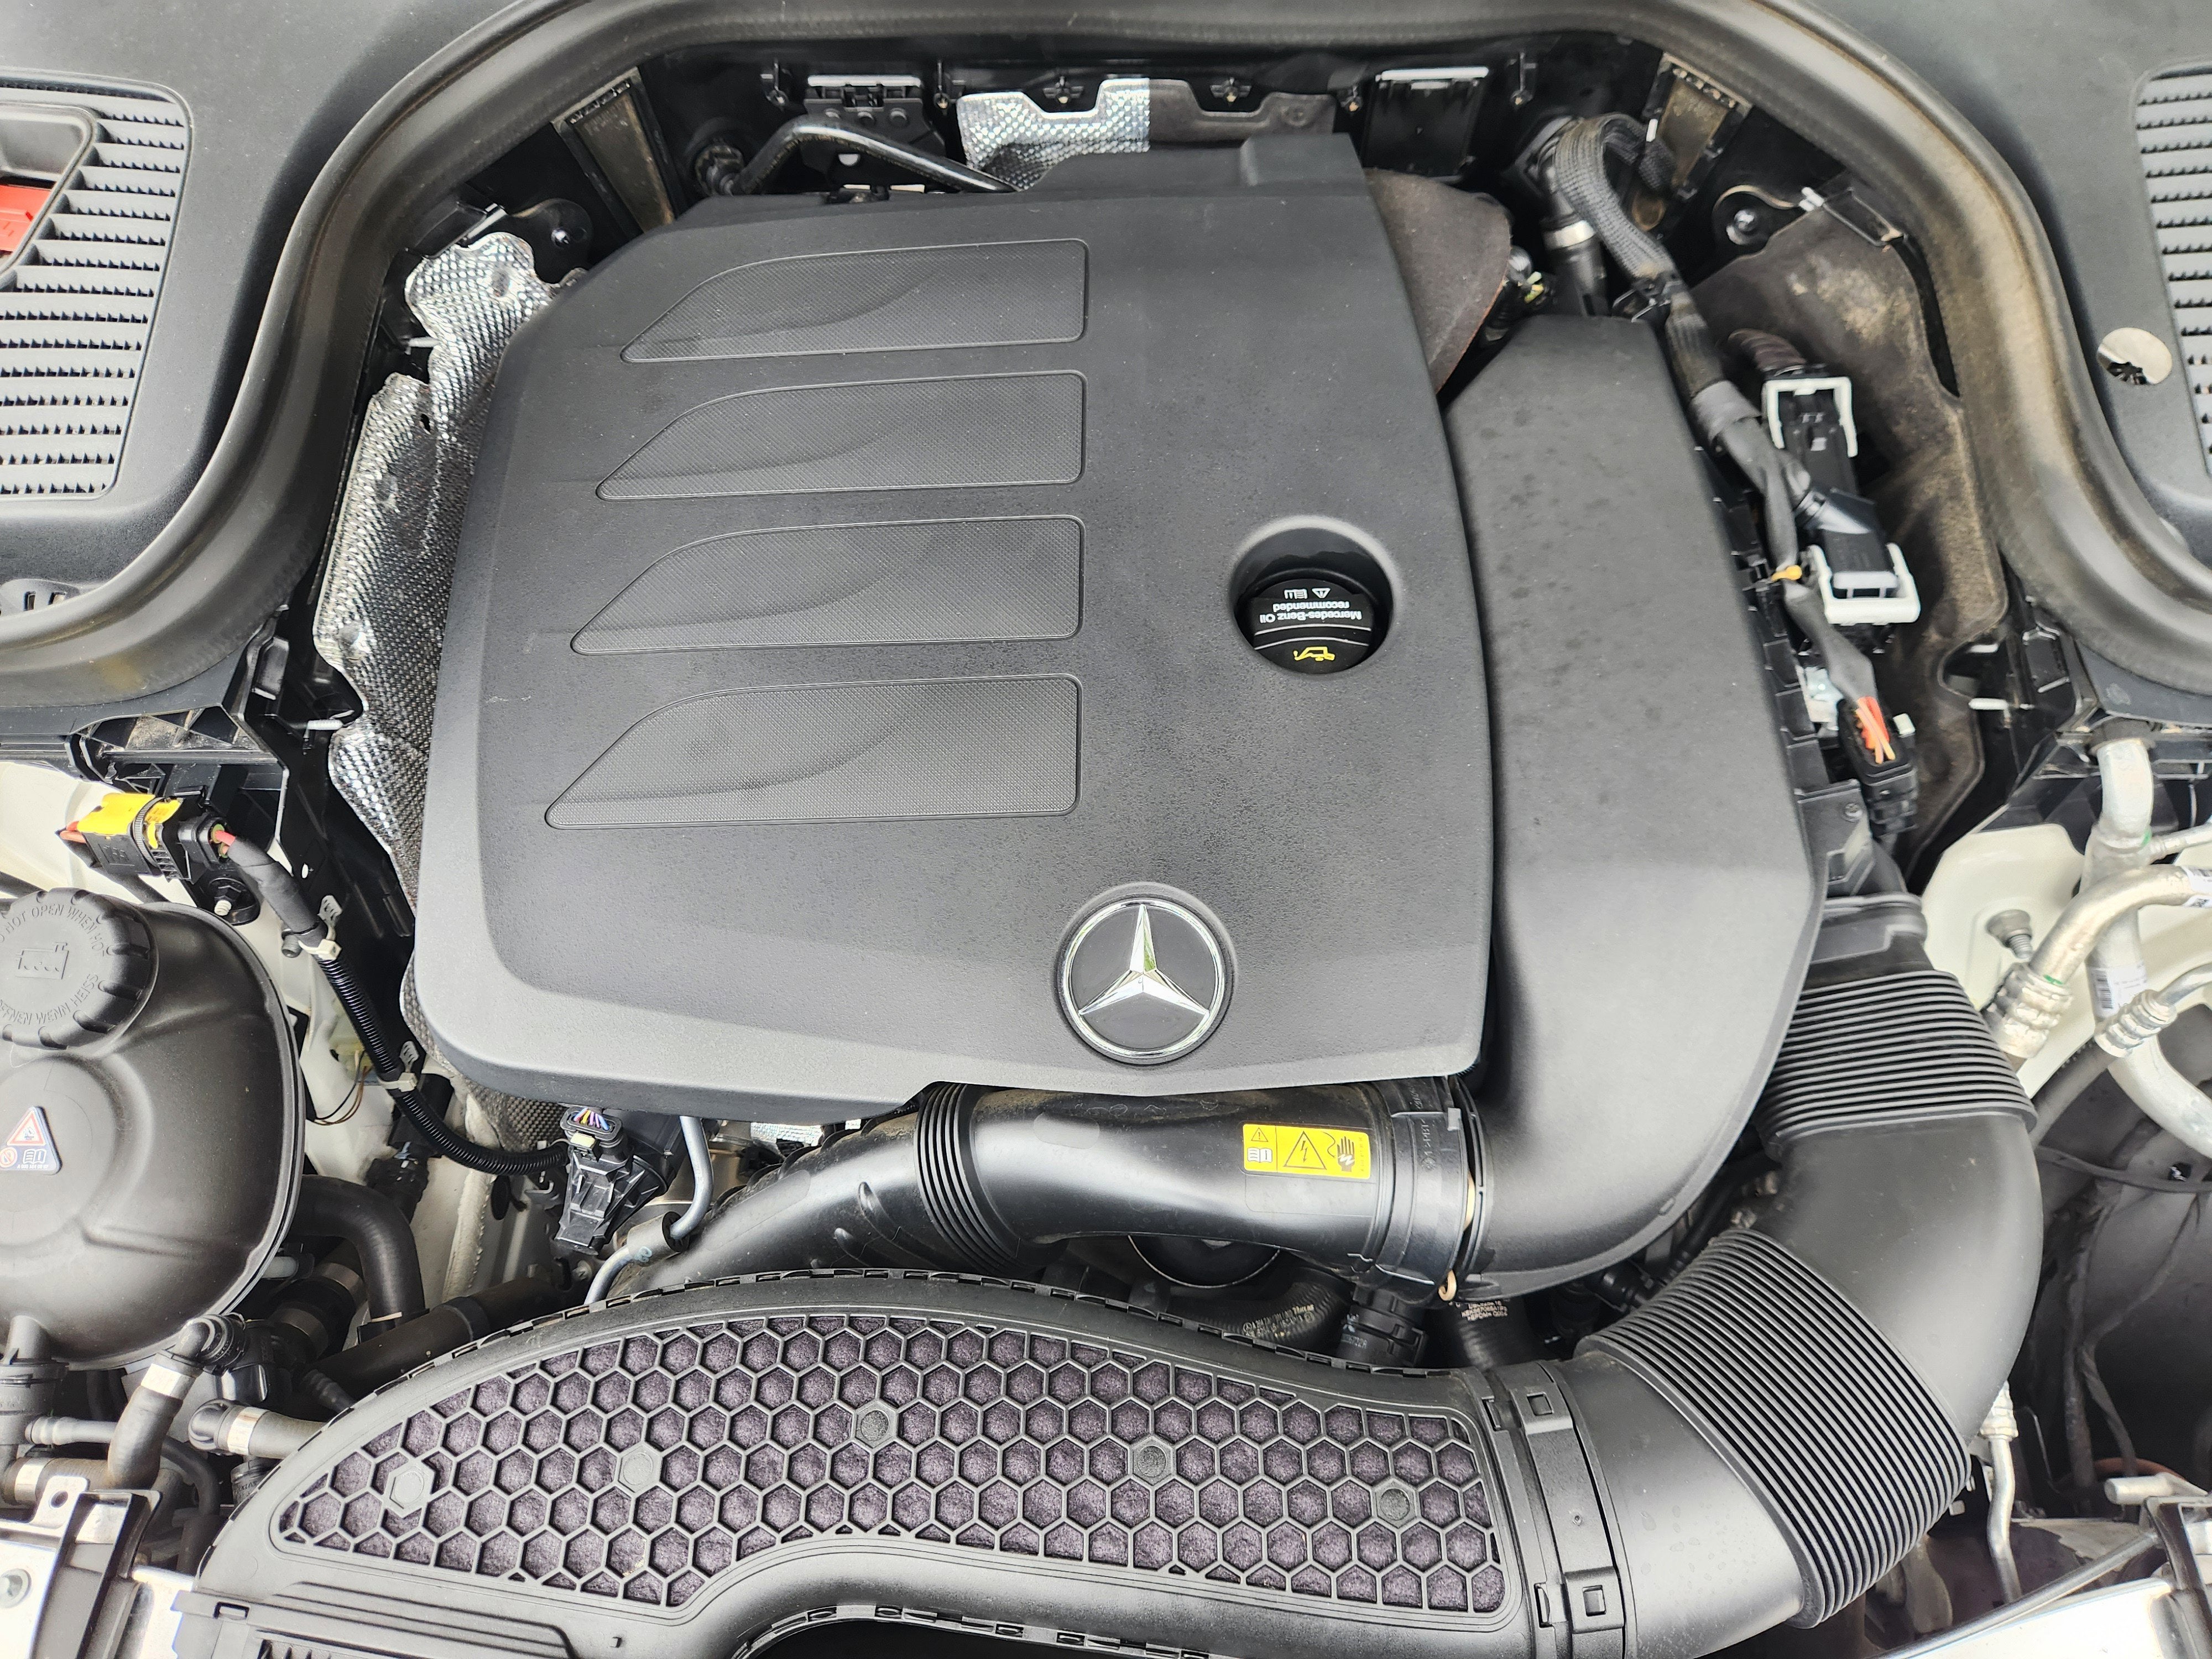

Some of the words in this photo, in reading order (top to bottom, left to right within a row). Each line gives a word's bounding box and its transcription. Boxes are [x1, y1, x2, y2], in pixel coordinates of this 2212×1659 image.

[1272, 601, 1350, 612] recommended
[1260, 614, 1275, 623] Oil
[1277, 611, 1362, 620] Mercedes-Benz
[5, 911, 26, 934] NOT
[32, 904, 64, 918] OPEN
[67, 906, 97, 935] WHEN
[36, 1002, 70, 1025] WENN
[70, 973, 99, 1006] HEISS
